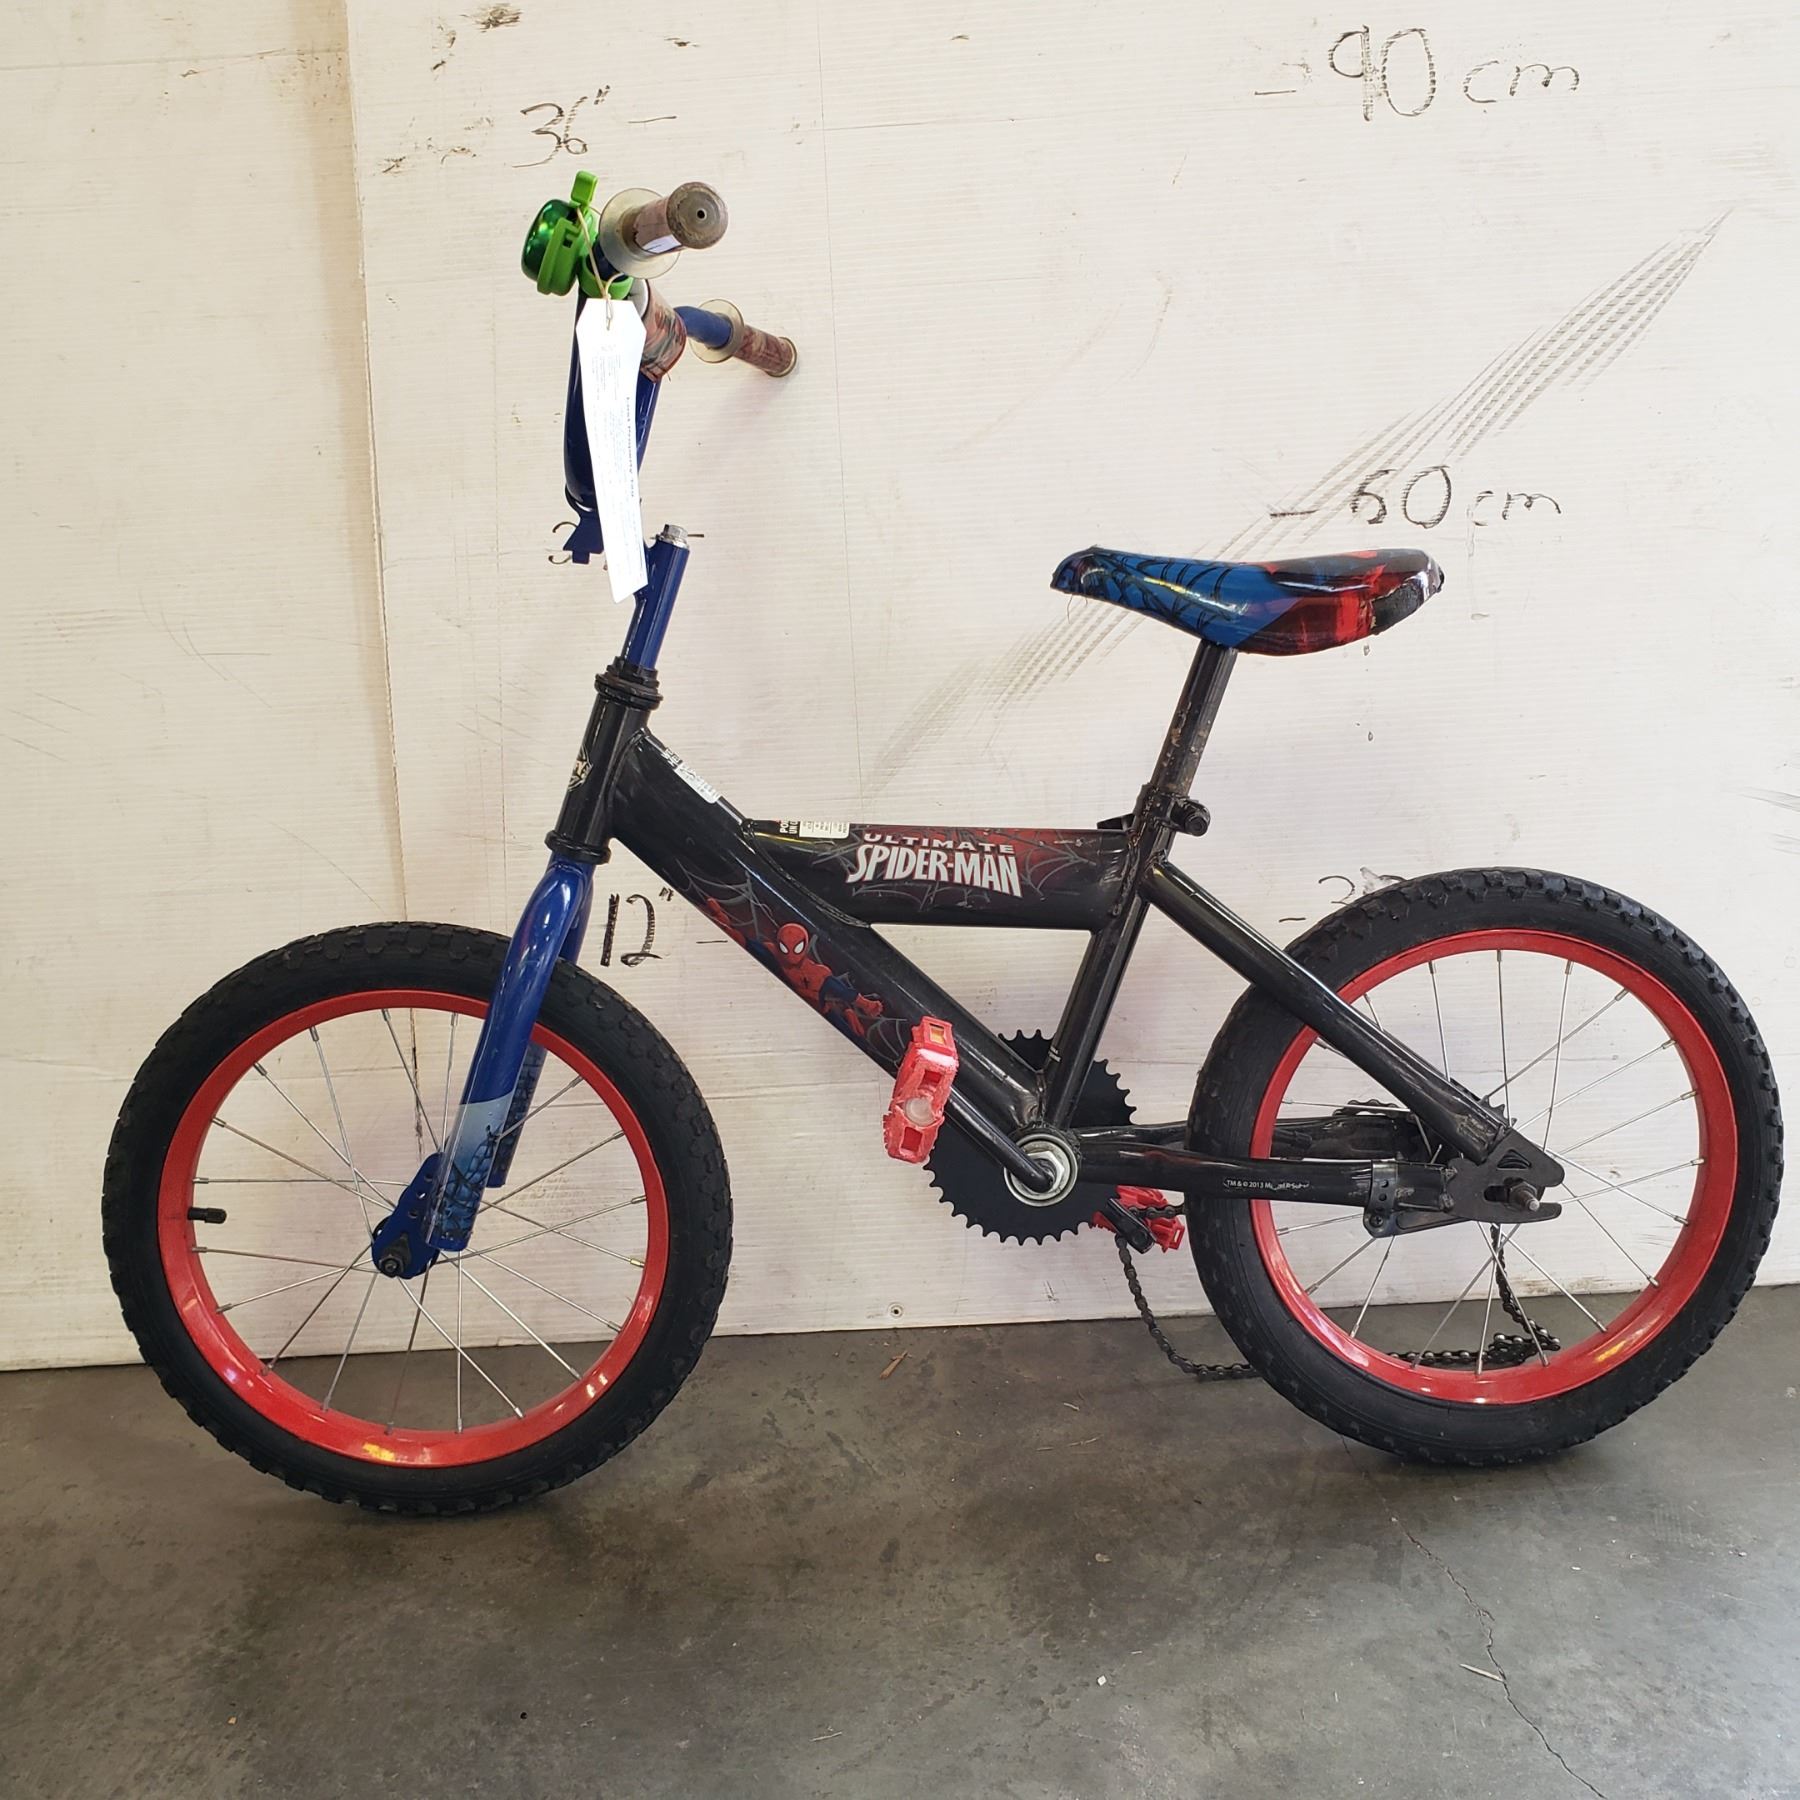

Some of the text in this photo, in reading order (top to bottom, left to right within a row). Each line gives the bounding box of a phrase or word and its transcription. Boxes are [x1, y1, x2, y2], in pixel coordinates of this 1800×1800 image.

[1328, 24, 1580, 121] 90 cm
[1472, 490, 1562, 527] cm
[863, 833, 1015, 854] ULTIMATE
[845, 844, 1023, 898] SPIDER-MAN
[1249, 1181, 1264, 1189] 2013
